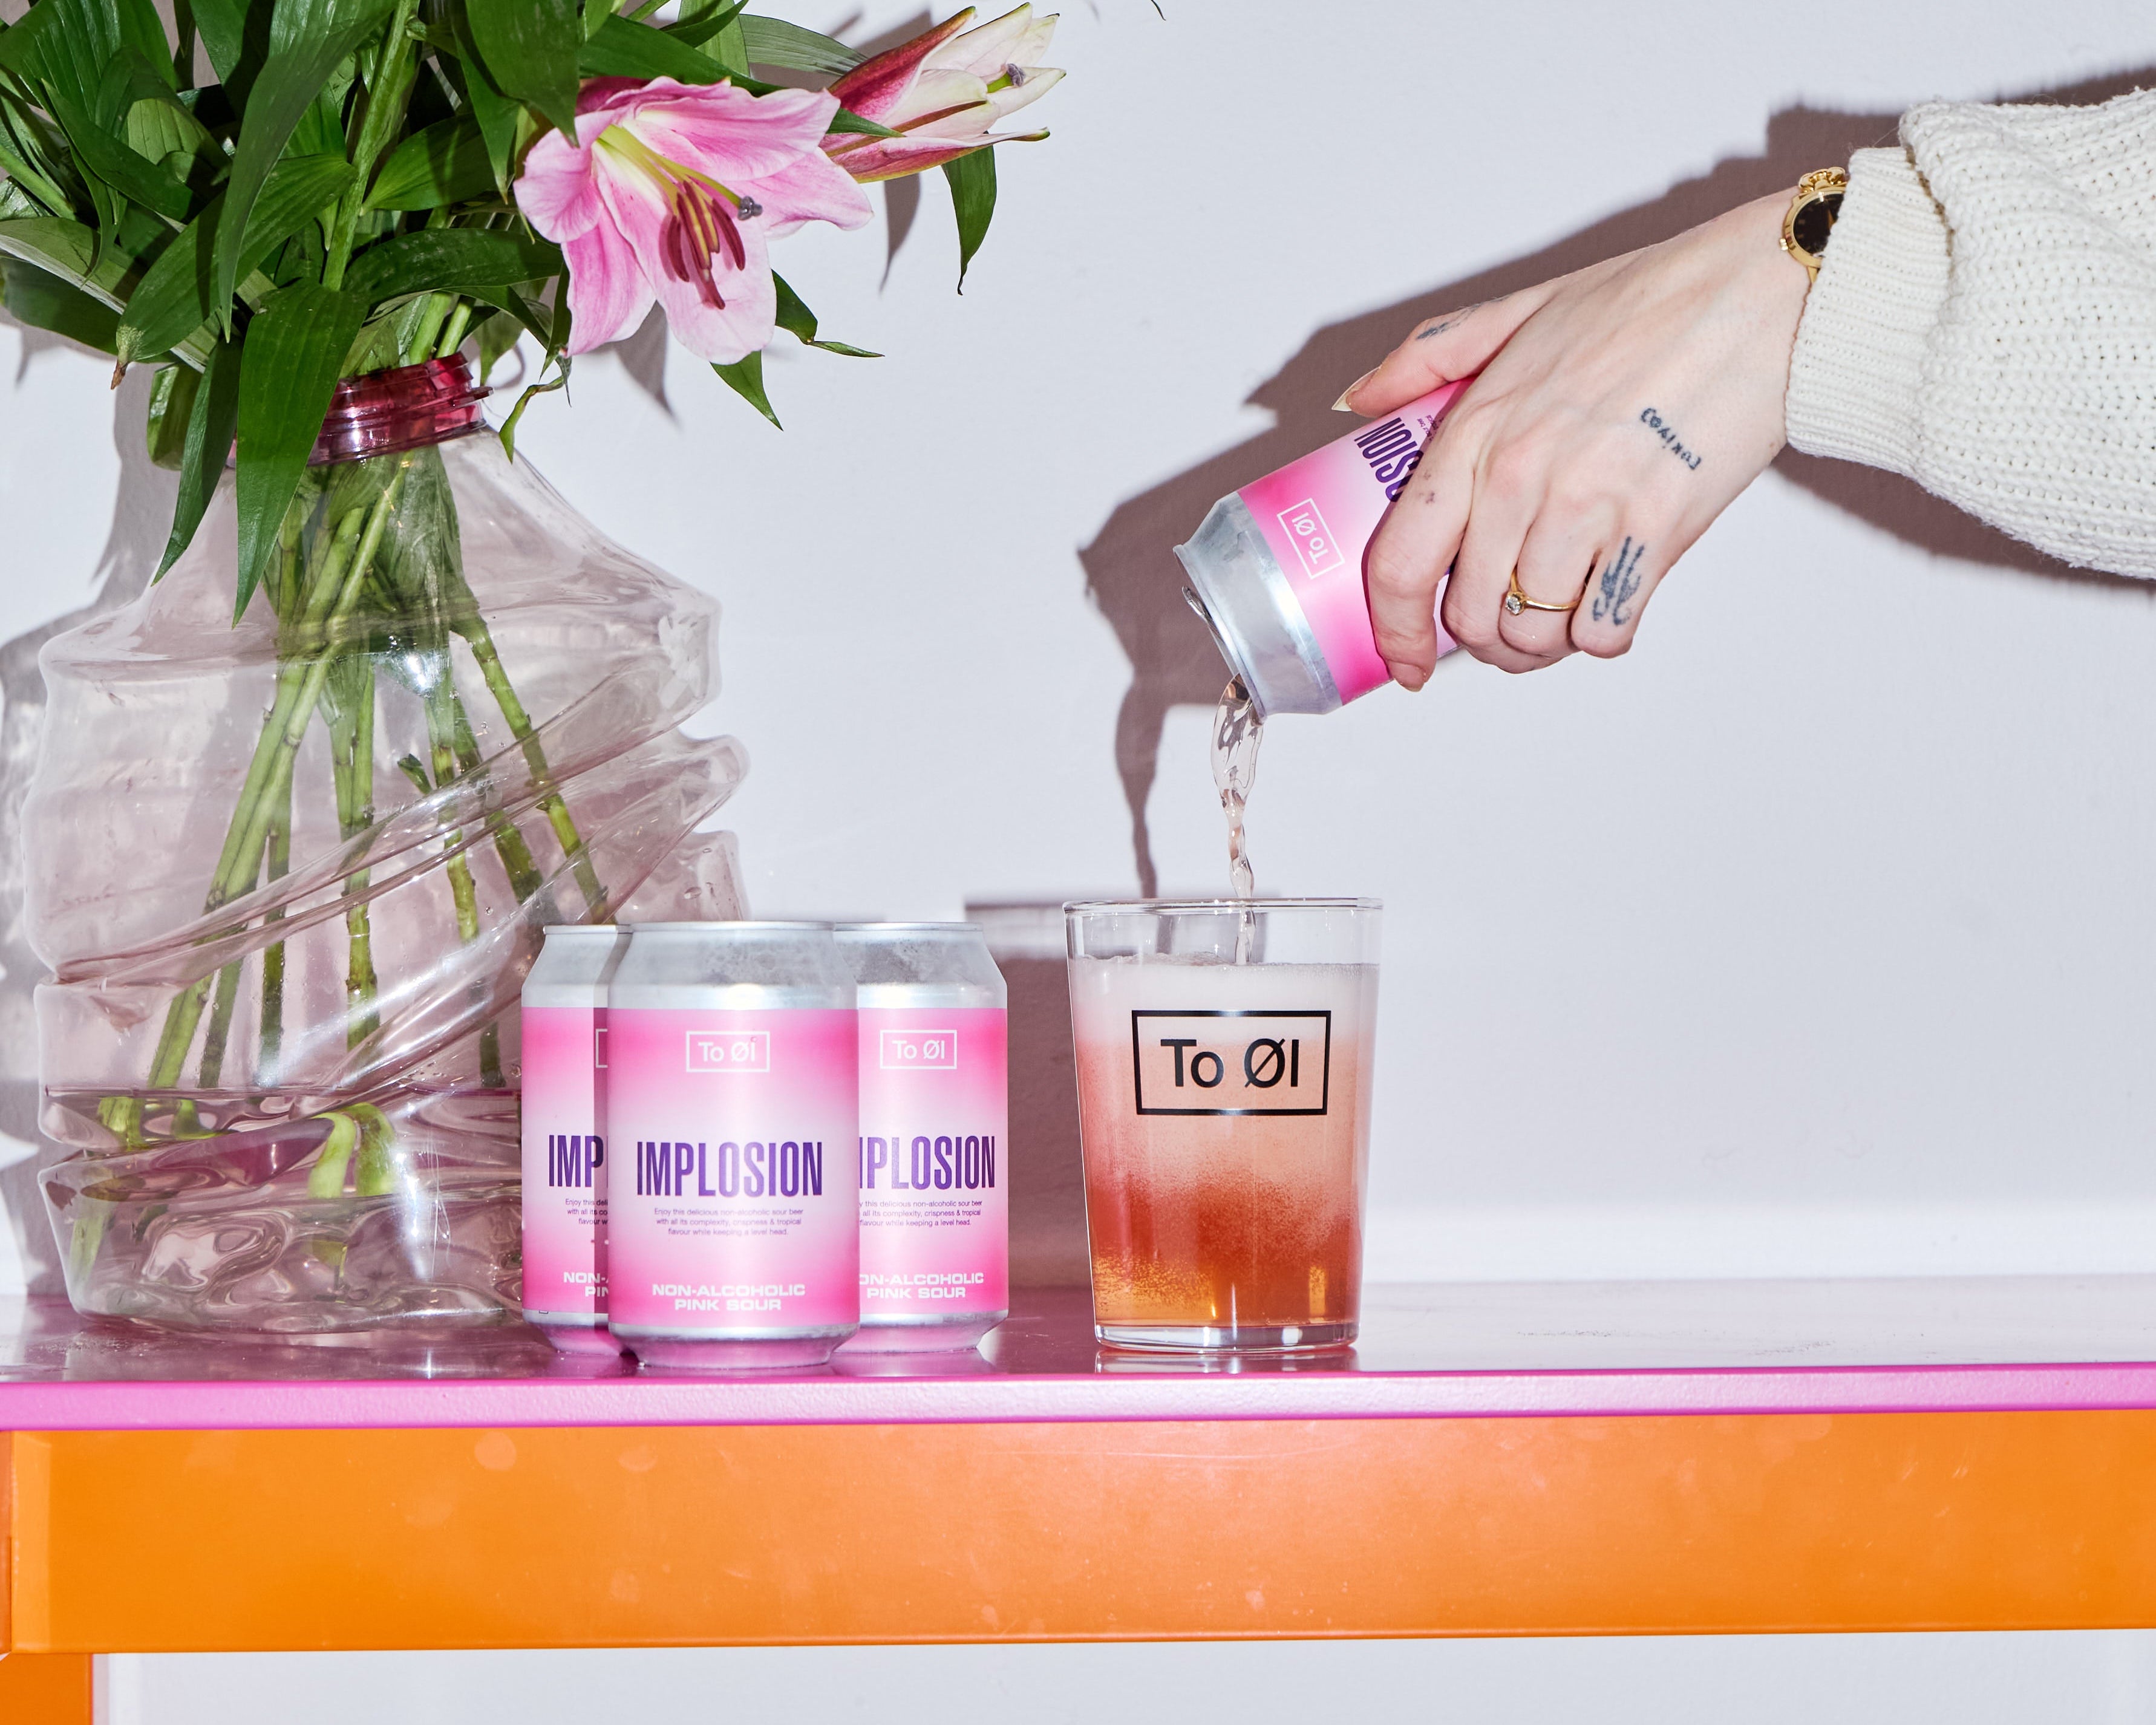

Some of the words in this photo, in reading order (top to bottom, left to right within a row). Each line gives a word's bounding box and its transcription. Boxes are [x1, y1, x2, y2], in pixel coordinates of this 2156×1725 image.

[1354, 417, 1424, 502] SION
[1308, 536, 1328, 564] To
[698, 1042, 724, 1062] To
[892, 1040, 917, 1059] To
[1160, 1039, 1224, 1088] To
[549, 1135, 608, 1188] IMP
[636, 1141, 823, 1196] IMPLOSION
[860, 1135, 995, 1190] PLOSION
[655, 1208, 670, 1217] Enjoy
[713, 1228, 742, 1237] keeping
[564, 1272, 608, 1283] NON-
[860, 1273, 984, 1285] ON-ALCOHOLIC
[652, 1283, 805, 1297] NON-ALCOHOLIC
[867, 1288, 911, 1299] PINK
[918, 1287, 965, 1299] SOUR
[675, 1299, 719, 1311] PINK
[726, 1299, 781, 1311] SOUR
